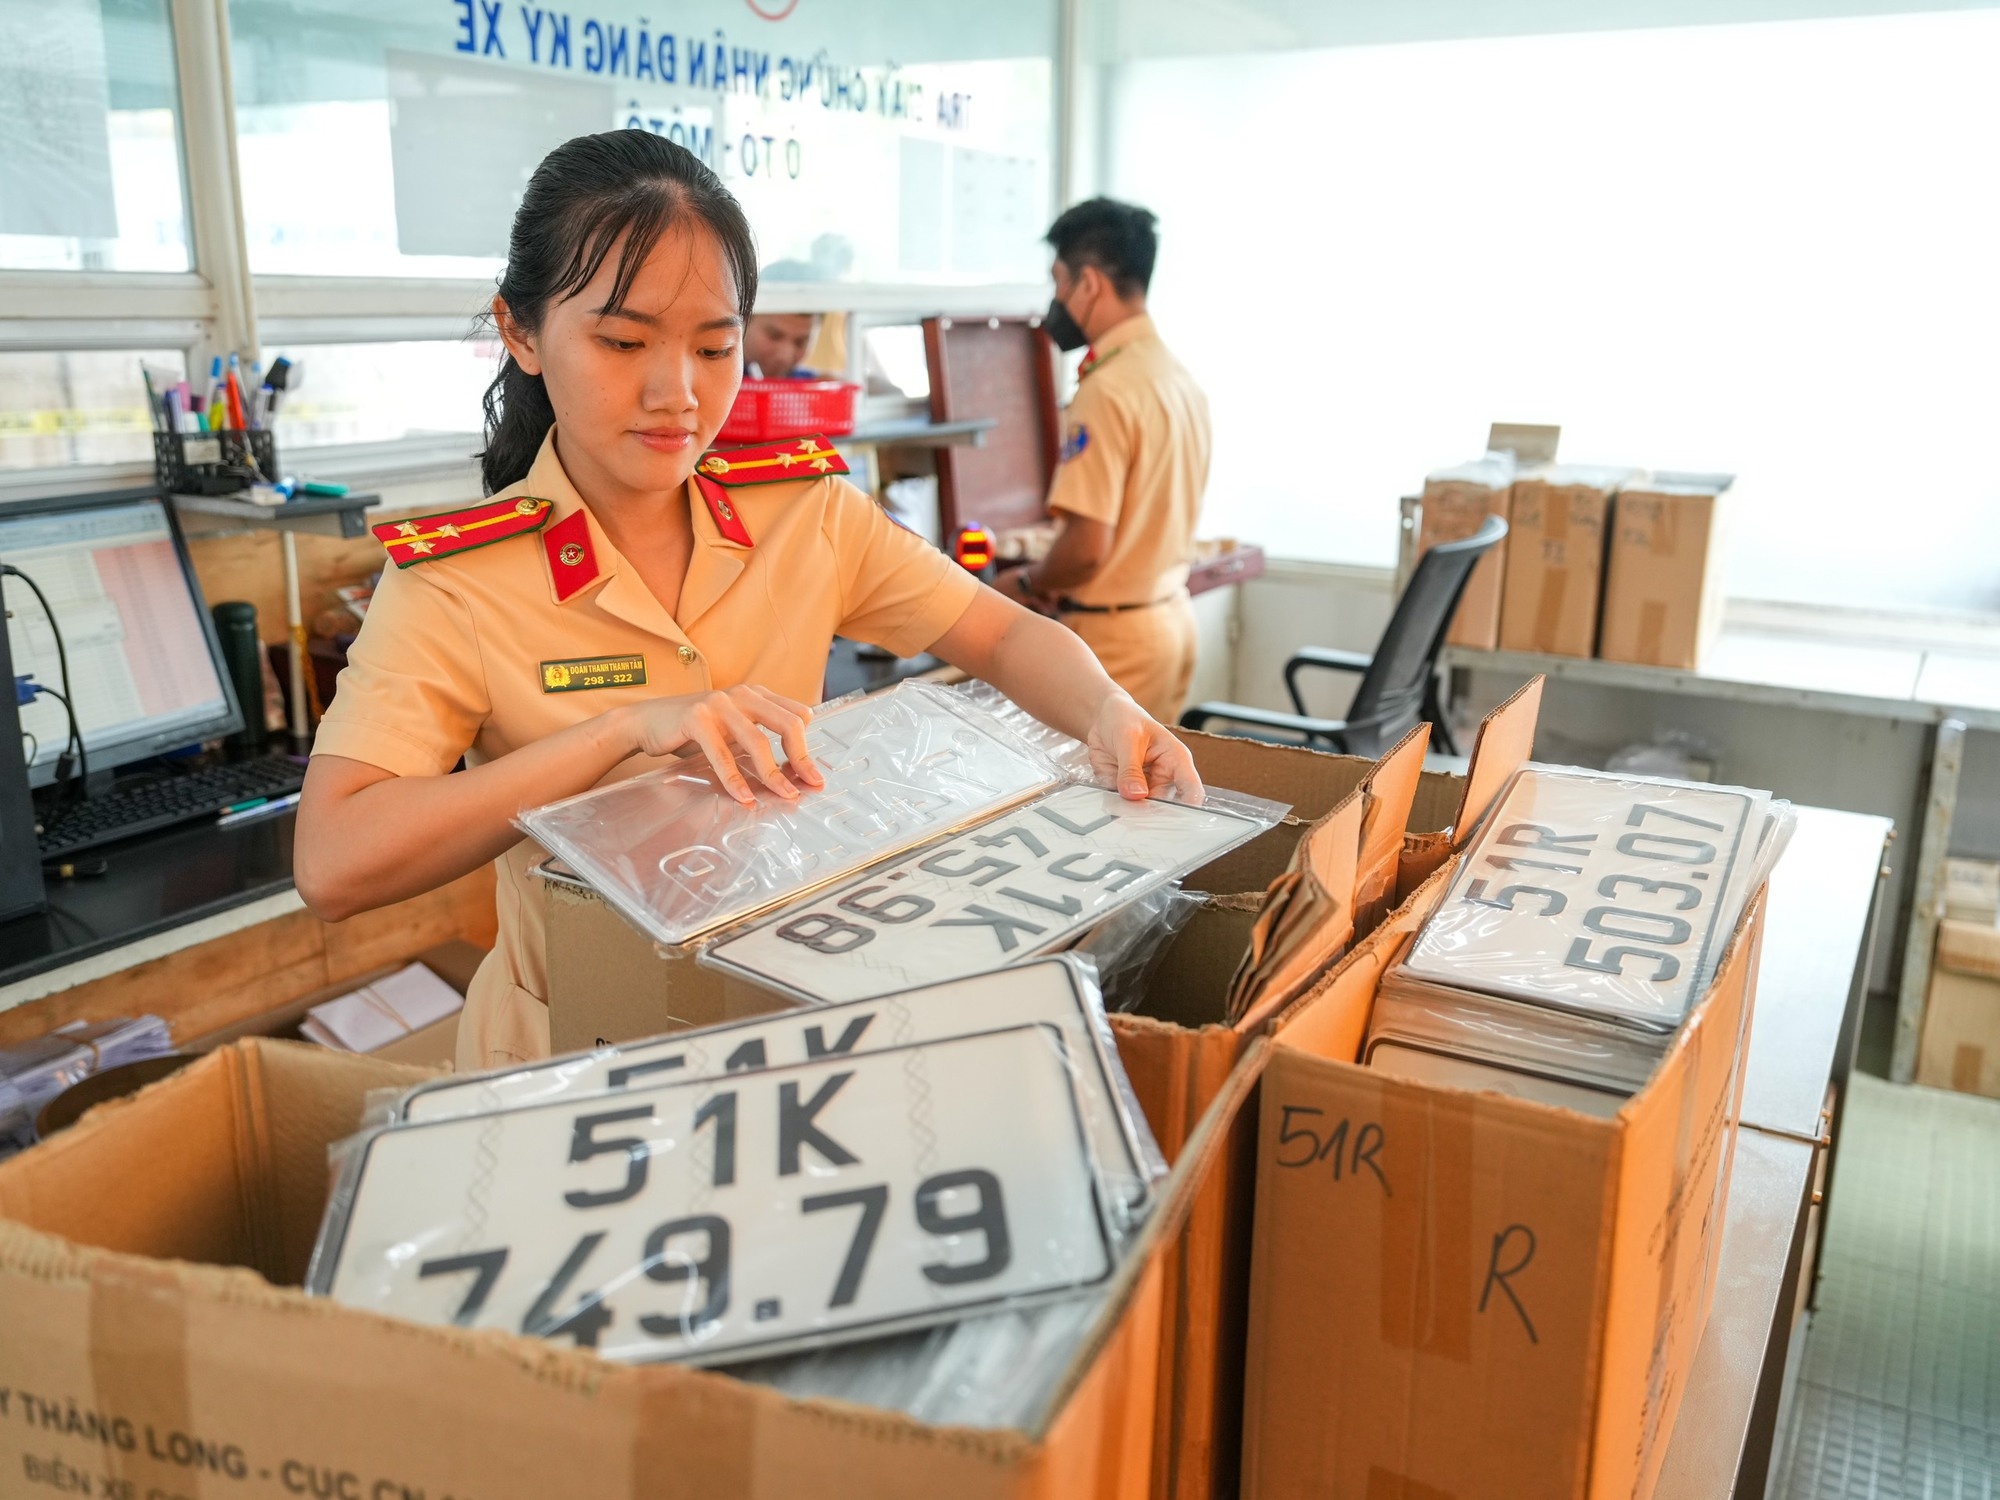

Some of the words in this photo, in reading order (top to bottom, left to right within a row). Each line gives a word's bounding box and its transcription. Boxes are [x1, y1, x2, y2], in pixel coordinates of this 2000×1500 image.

[584, 676, 604, 686] 298
[613, 673, 632, 683] 322
[776, 806, 1119, 954] 745.98
[929, 852, 1155, 953] 51K
[1462, 823, 1598, 917] 51R
[1564, 804, 1725, 982] 503.07
[564, 1070, 863, 1209] 51K
[1276, 1105, 1393, 1199] 51R
[418, 1168, 1013, 1350] 749.79
[1479, 1223, 1540, 1345] R
[145, 1424, 248, 1481] LONG
